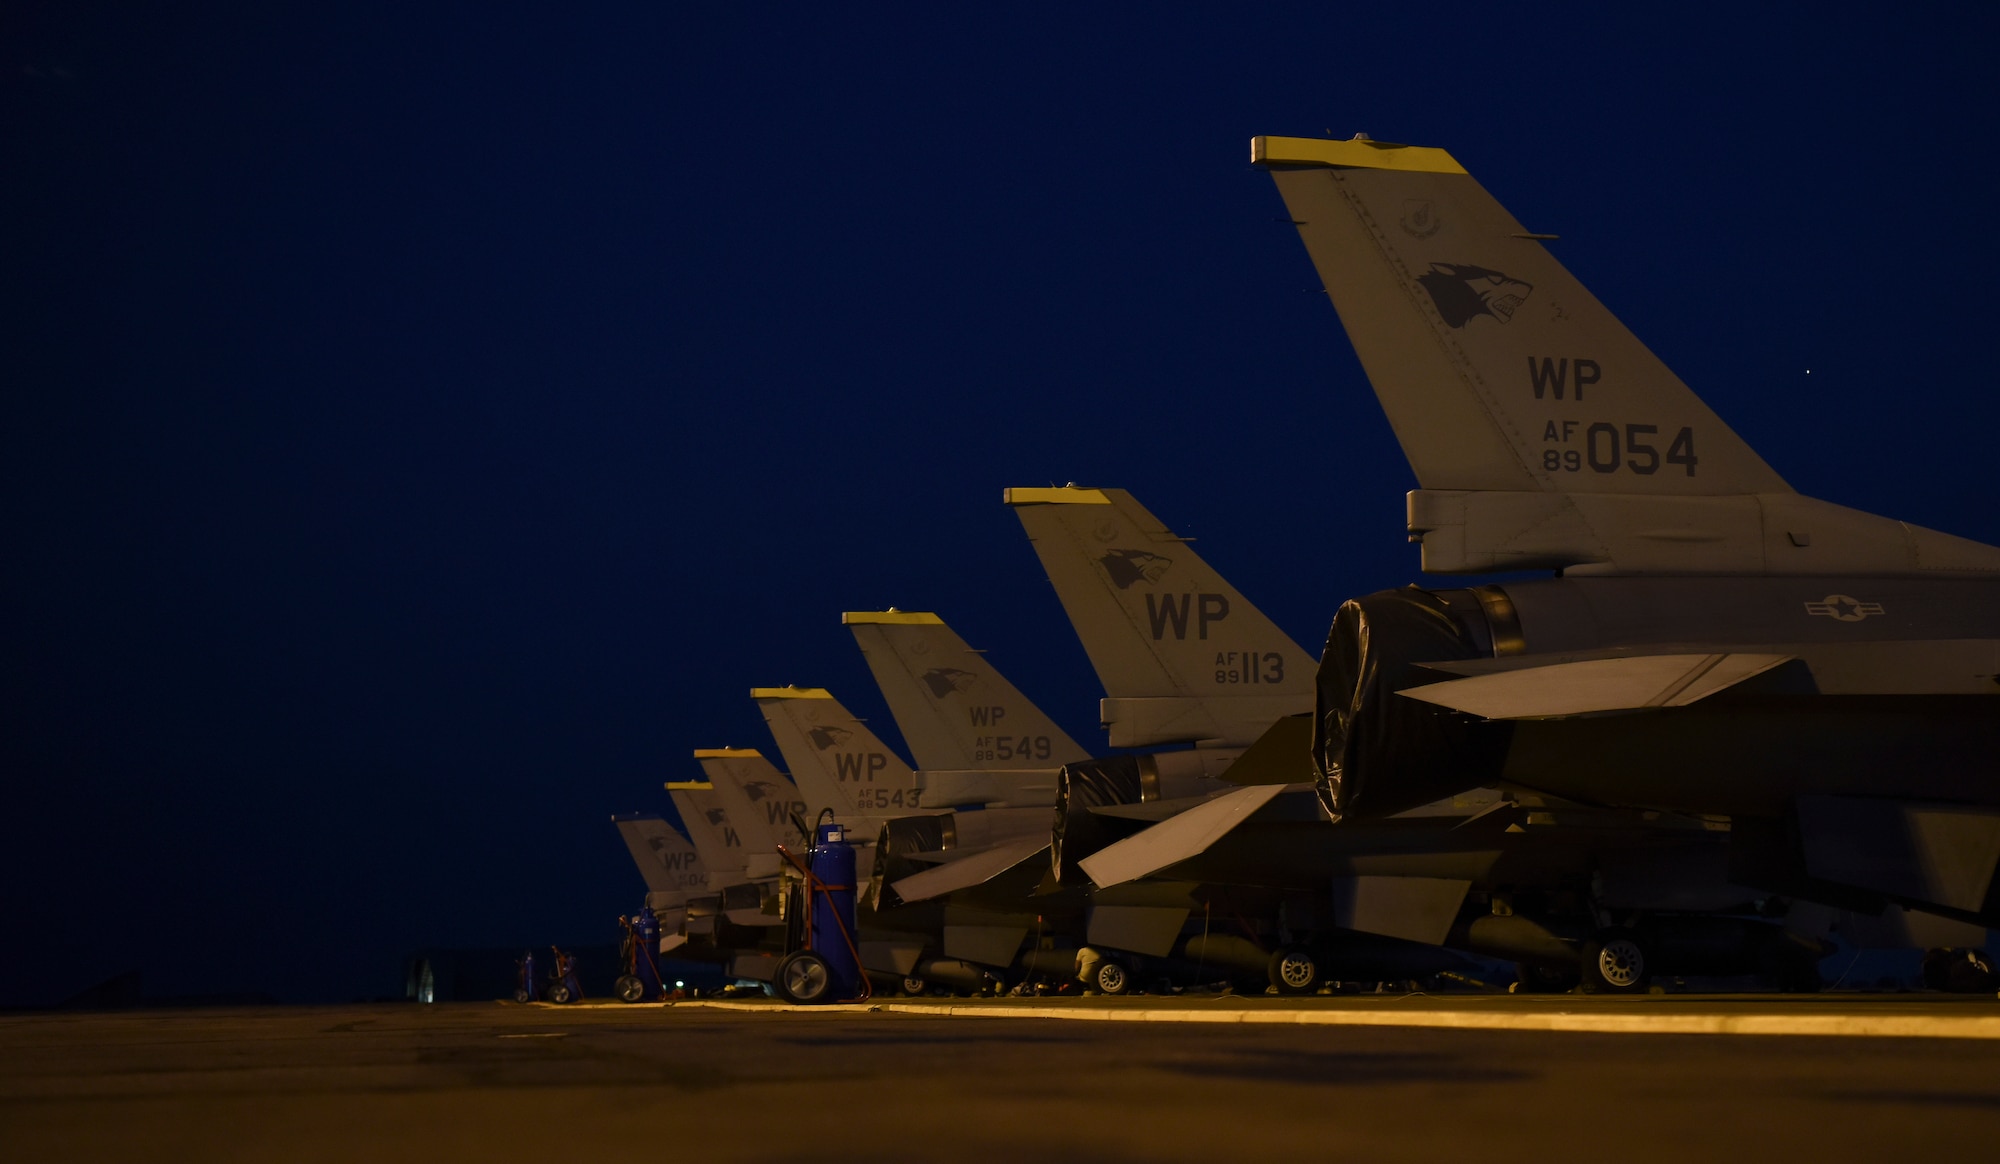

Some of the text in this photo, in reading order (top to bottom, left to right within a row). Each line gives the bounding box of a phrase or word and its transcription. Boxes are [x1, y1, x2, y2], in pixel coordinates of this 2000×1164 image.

[1527, 355, 1601, 401] WP
[1543, 420, 1579, 442] AF
[1587, 422, 1698, 477] 054
[1543, 450, 1581, 472] 89
[1145, 593, 1229, 640] WP
[1215, 652, 1238, 666] AF
[1243, 652, 1284, 684] 113
[1215, 670, 1239, 684] 89
[969, 706, 1005, 727] WP
[976, 737, 993, 748] AF
[996, 736, 1051, 760] 549
[975, 750, 994, 761] 88
[835, 752, 887, 782] WP
[858, 789, 872, 798] AF
[875, 789, 920, 808] 543
[766, 801, 807, 825] WP
[858, 800, 873, 809] 88
[664, 852, 697, 870] WP
